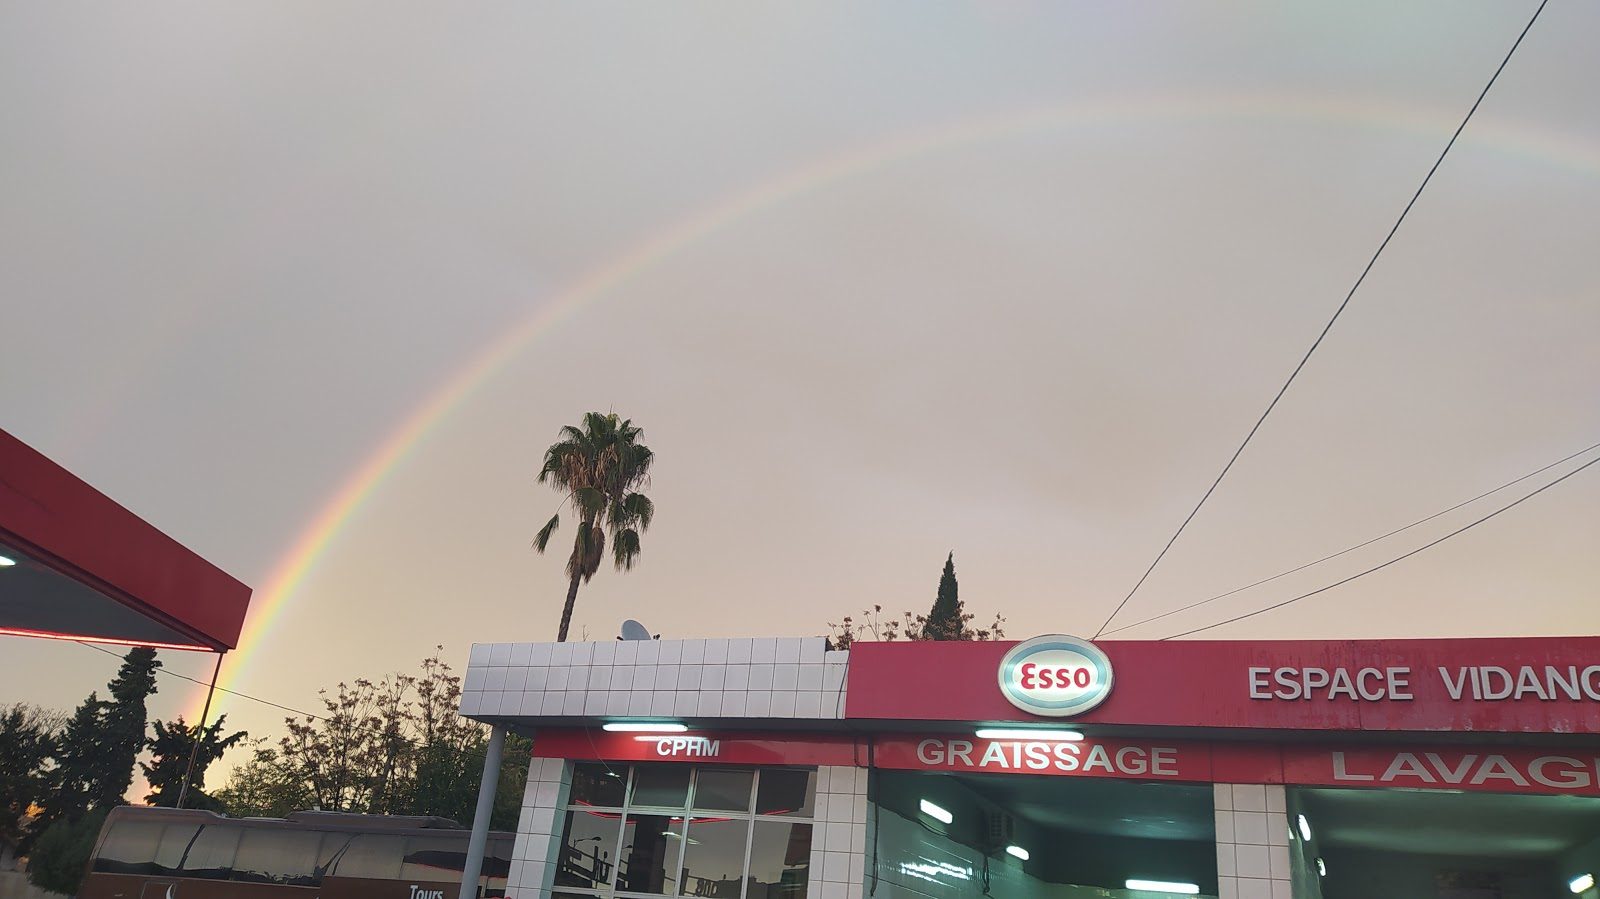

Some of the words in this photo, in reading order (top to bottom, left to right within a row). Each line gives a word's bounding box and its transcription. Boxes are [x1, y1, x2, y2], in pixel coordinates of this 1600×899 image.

[1020, 663, 1091, 690] Esso
[1248, 666, 1414, 701] ESPACE
[656, 738, 720, 758] CPHM
[916, 738, 1180, 777] GRAISSAGE
[1332, 751, 1600, 789] LAVAG
[409, 884, 444, 899] Tours
